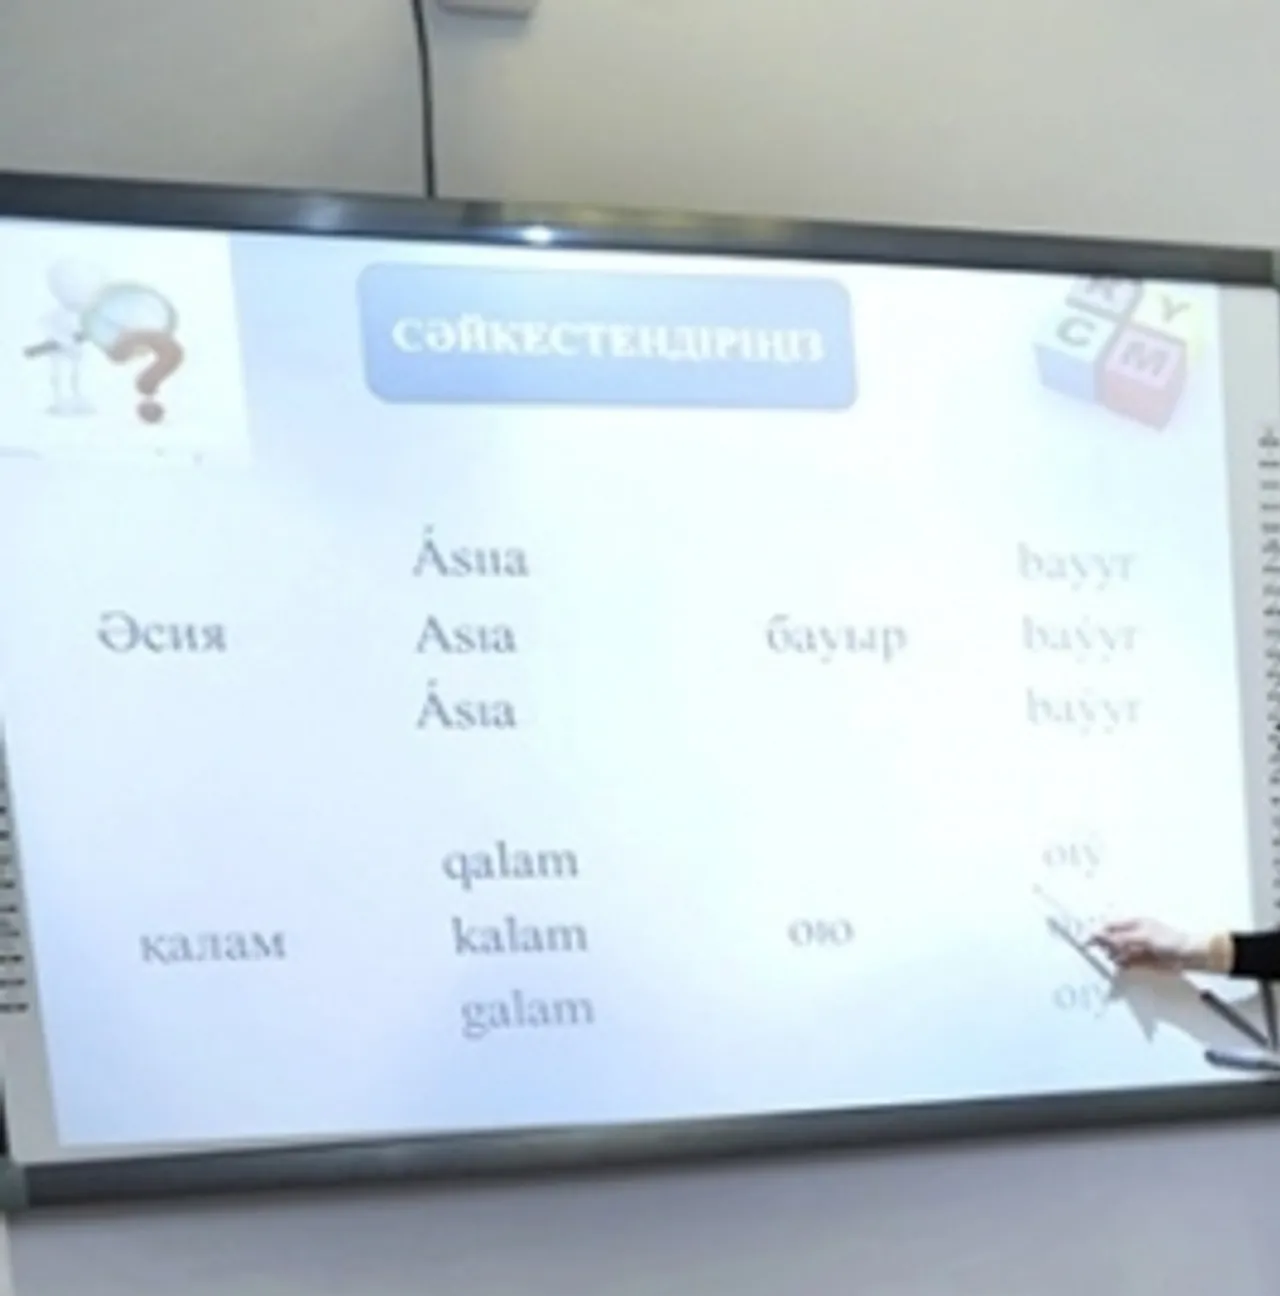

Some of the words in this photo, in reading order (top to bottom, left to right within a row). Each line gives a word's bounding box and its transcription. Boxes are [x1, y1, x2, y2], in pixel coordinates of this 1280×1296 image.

[96, 609, 228, 654] Әсия
[765, 613, 909, 664] бауыр
[440, 839, 579, 891] qalam
[450, 914, 589, 956] kalam
[787, 917, 855, 947] ою
[460, 989, 597, 1040] galam
